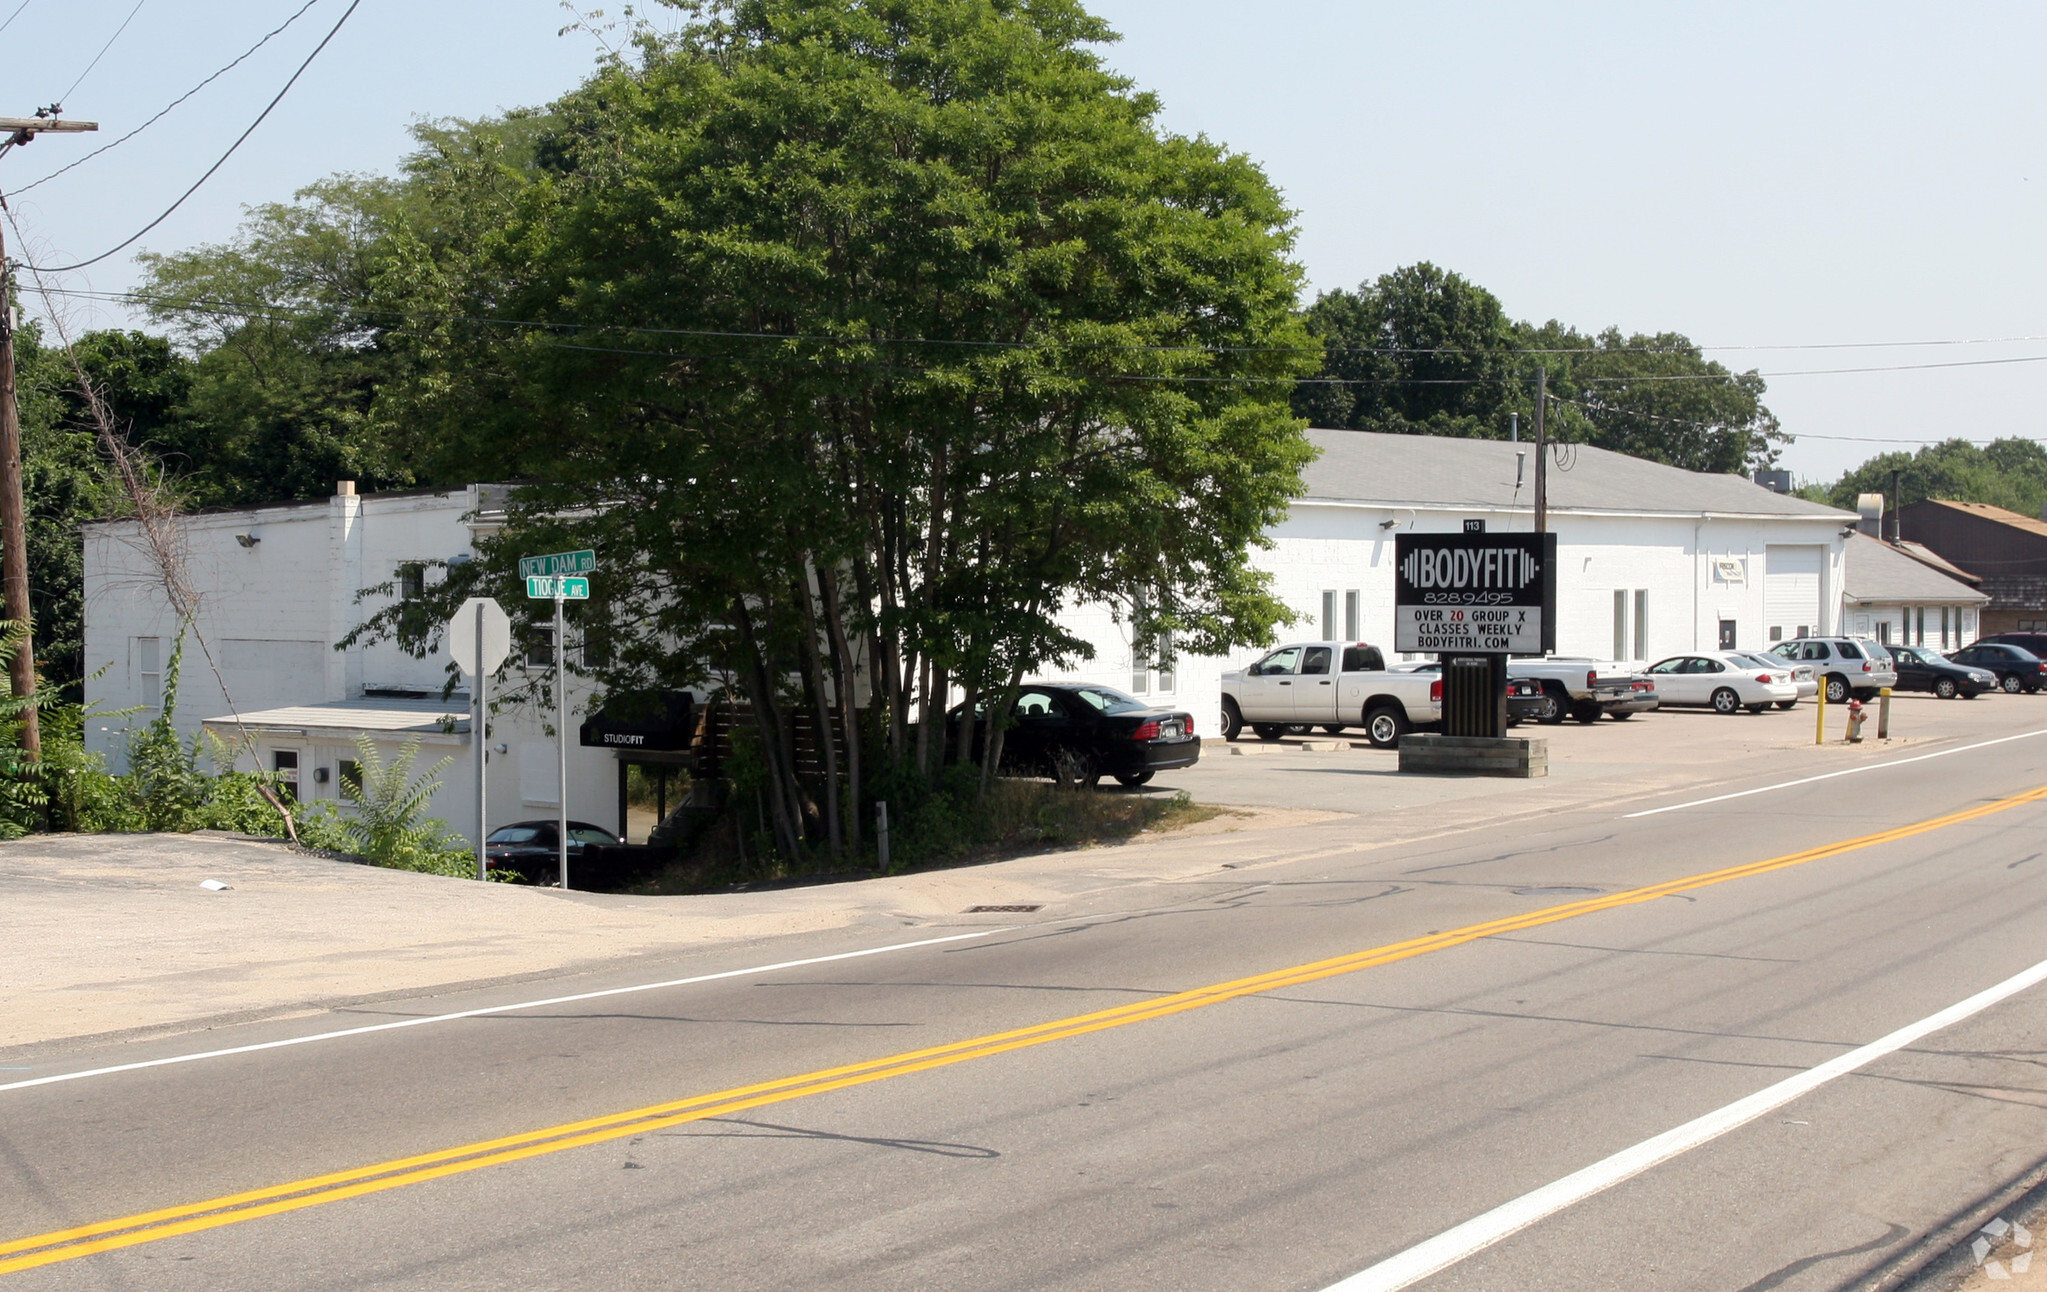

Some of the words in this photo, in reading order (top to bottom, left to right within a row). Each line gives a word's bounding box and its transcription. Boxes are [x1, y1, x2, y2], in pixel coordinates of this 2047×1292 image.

[1465, 521, 1480, 531] 113
[521, 558, 546, 577] NEW
[551, 554, 576, 574] DAM
[580, 557, 592, 570] RD
[1420, 548, 1518, 589] BODYFIT
[532, 578, 567, 596] TIOGUE
[570, 584, 584, 597] AVE
[1424, 590, 1513, 606] 828.9495
[1414, 610, 1443, 622] OVER
[1450, 610, 1464, 622] 20
[1471, 611, 1509, 622] GROUP
[1518, 611, 1525, 622] X
[1419, 624, 1469, 635] CLASSES
[1477, 624, 1522, 635] WEEKLY
[604, 733, 645, 745] STUDIOFIT
